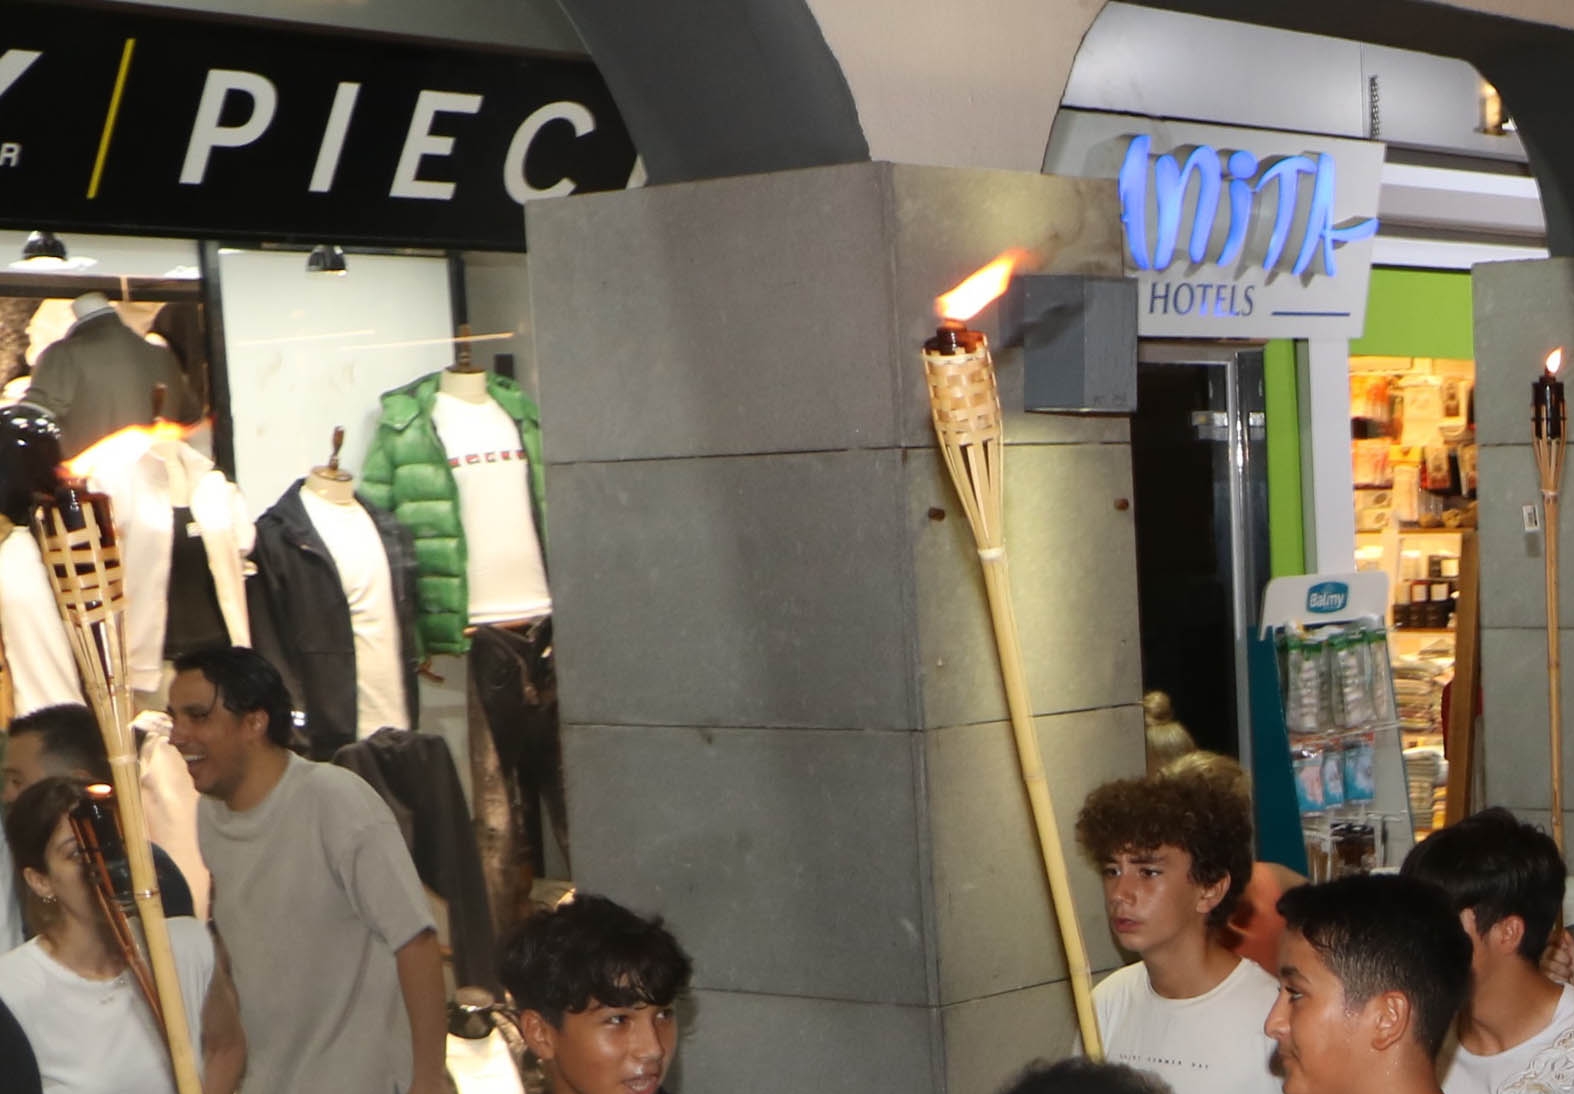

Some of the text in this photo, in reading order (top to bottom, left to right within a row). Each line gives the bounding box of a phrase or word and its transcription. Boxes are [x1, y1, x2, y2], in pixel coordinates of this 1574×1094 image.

[179, 69, 647, 205] PIEC
[1148, 281, 1255, 318] HOTELS
[1310, 591, 1345, 608] Balmy
